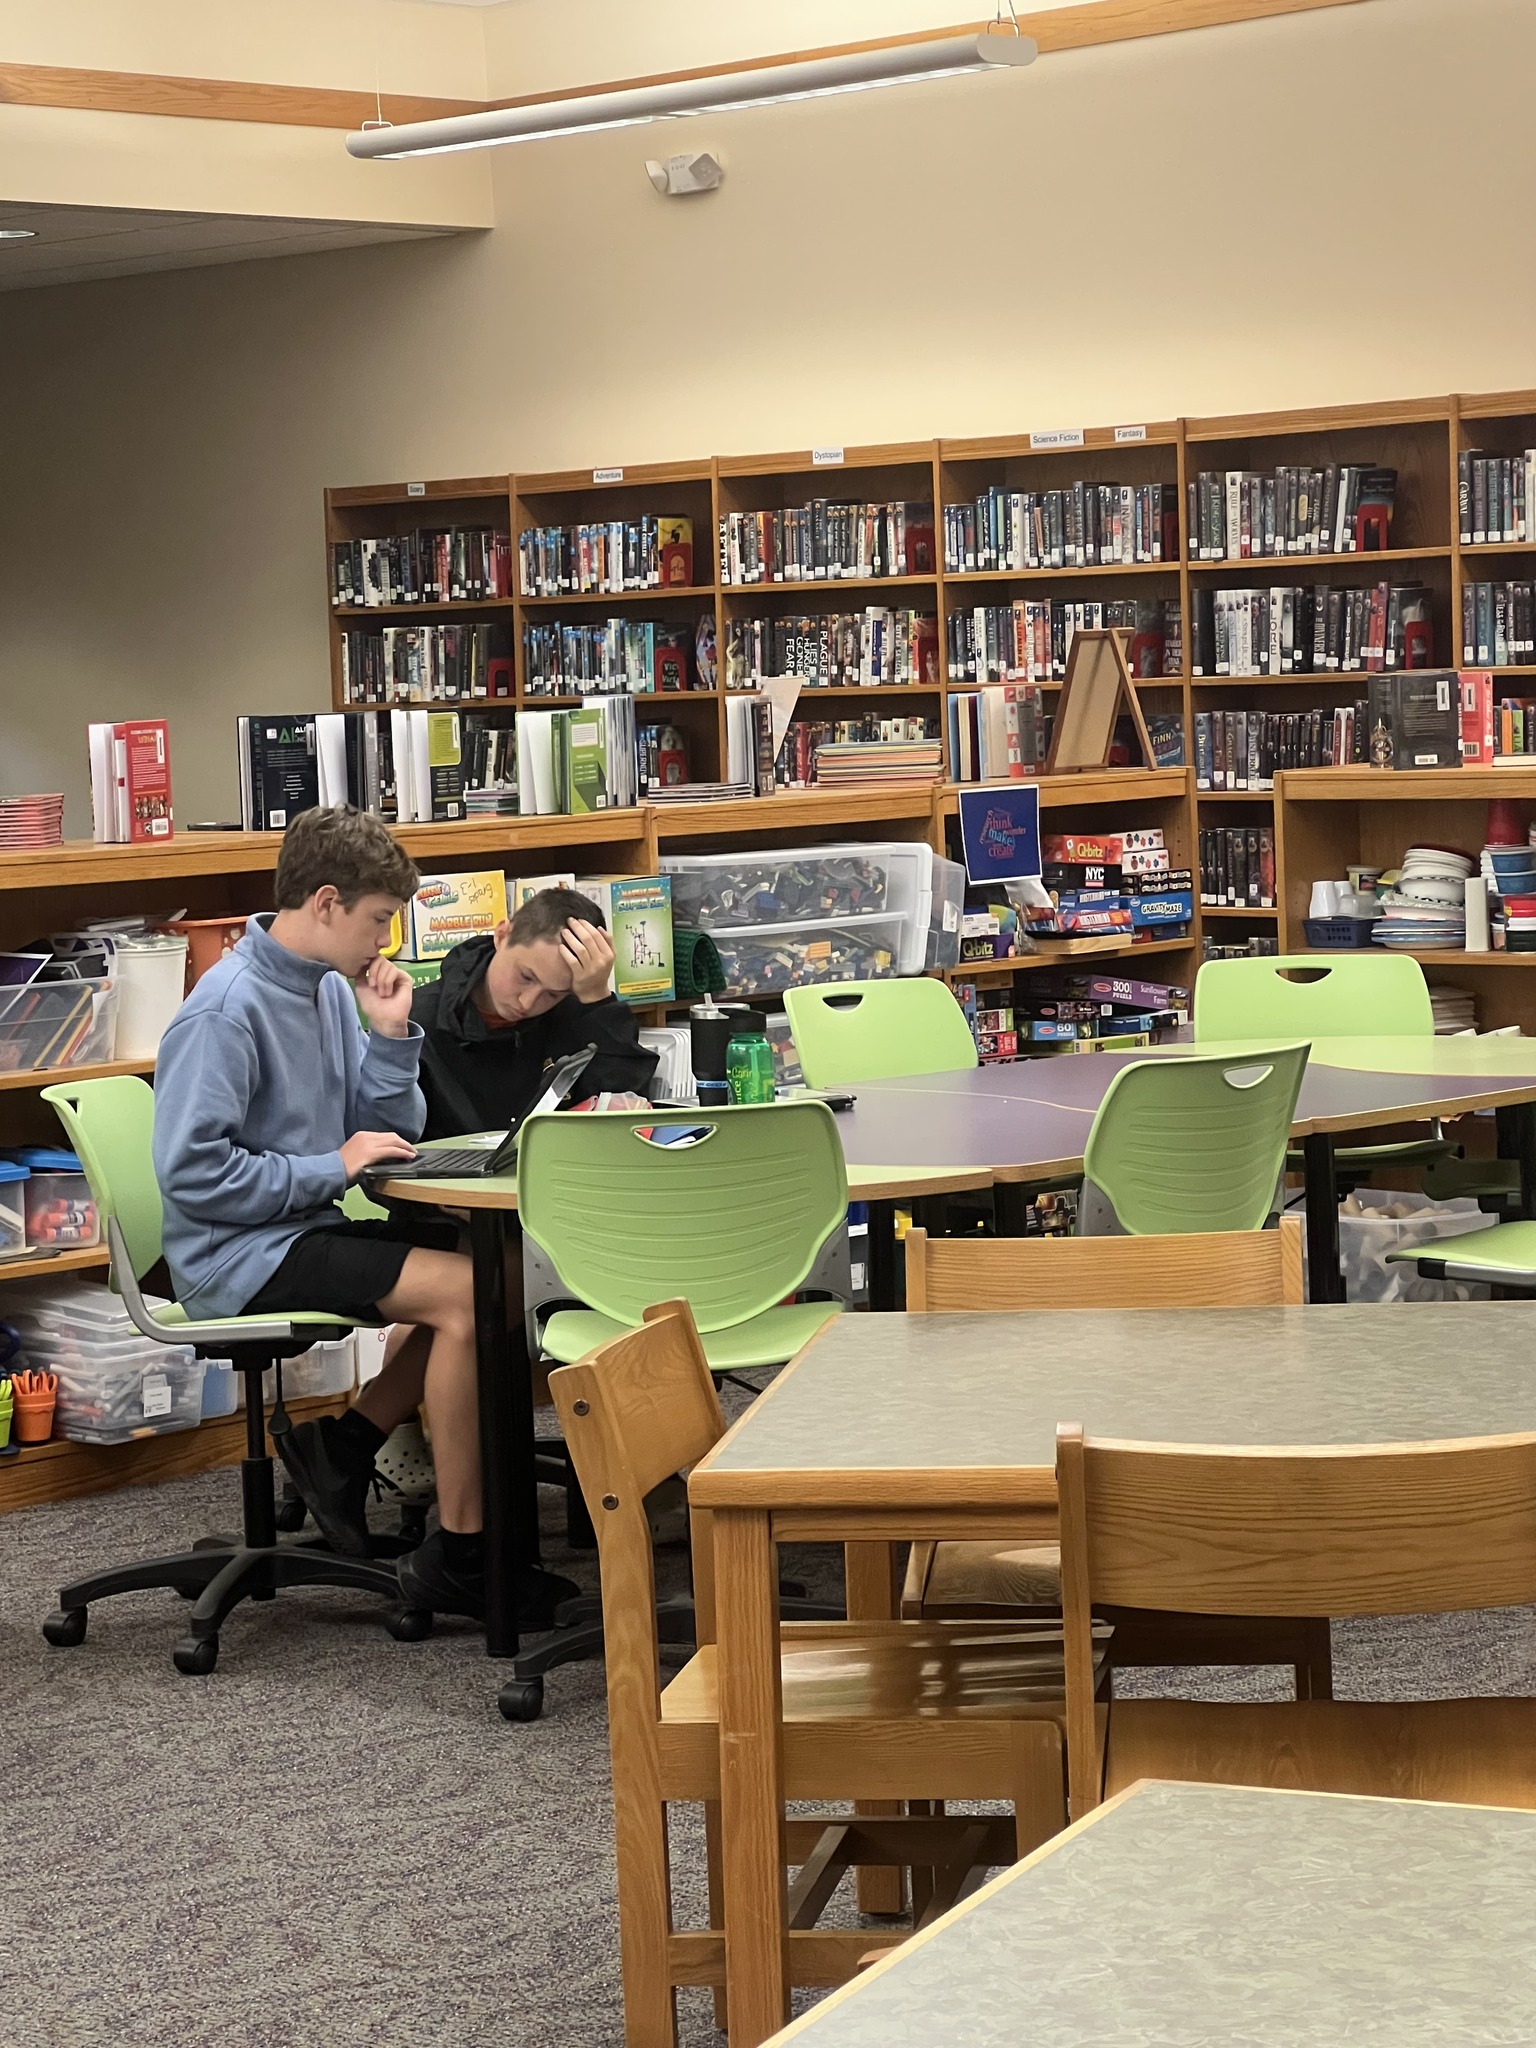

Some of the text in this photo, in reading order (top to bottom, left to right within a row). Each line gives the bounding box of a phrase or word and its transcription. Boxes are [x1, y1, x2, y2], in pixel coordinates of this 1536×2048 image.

[1032, 432, 1080, 444] Science Fiction
[1117, 429, 1143, 439] Fantasy
[814, 450, 843, 460] Dystopian
[595, 471, 622, 481] Adventure
[1230, 491, 1238, 510] RULE
[1375, 606, 1384, 648] SPIN
[786, 638, 795, 668] FEAR
[809, 642, 817, 664] LIES
[820, 630, 828, 675] PLAGUE
[639, 739, 647, 776] SUPERNOV
[989, 816, 1013, 830] think
[989, 828, 1013, 847] make
[988, 846, 1015, 857] create
[1085, 866, 1105, 880] NYC
[617, 898, 648, 912] SUPER
[1142, 902, 1182, 914] GRAVITY MAZE
[430, 912, 493, 932] MARBLE RUN
[422, 931, 478, 953] STAR
[1112, 992, 1132, 1000] PUZZLE
[1140, 984, 1168, 996] Sunflower
[1153, 995, 1168, 1006] Farm
[1057, 1023, 1072, 1032] 60
